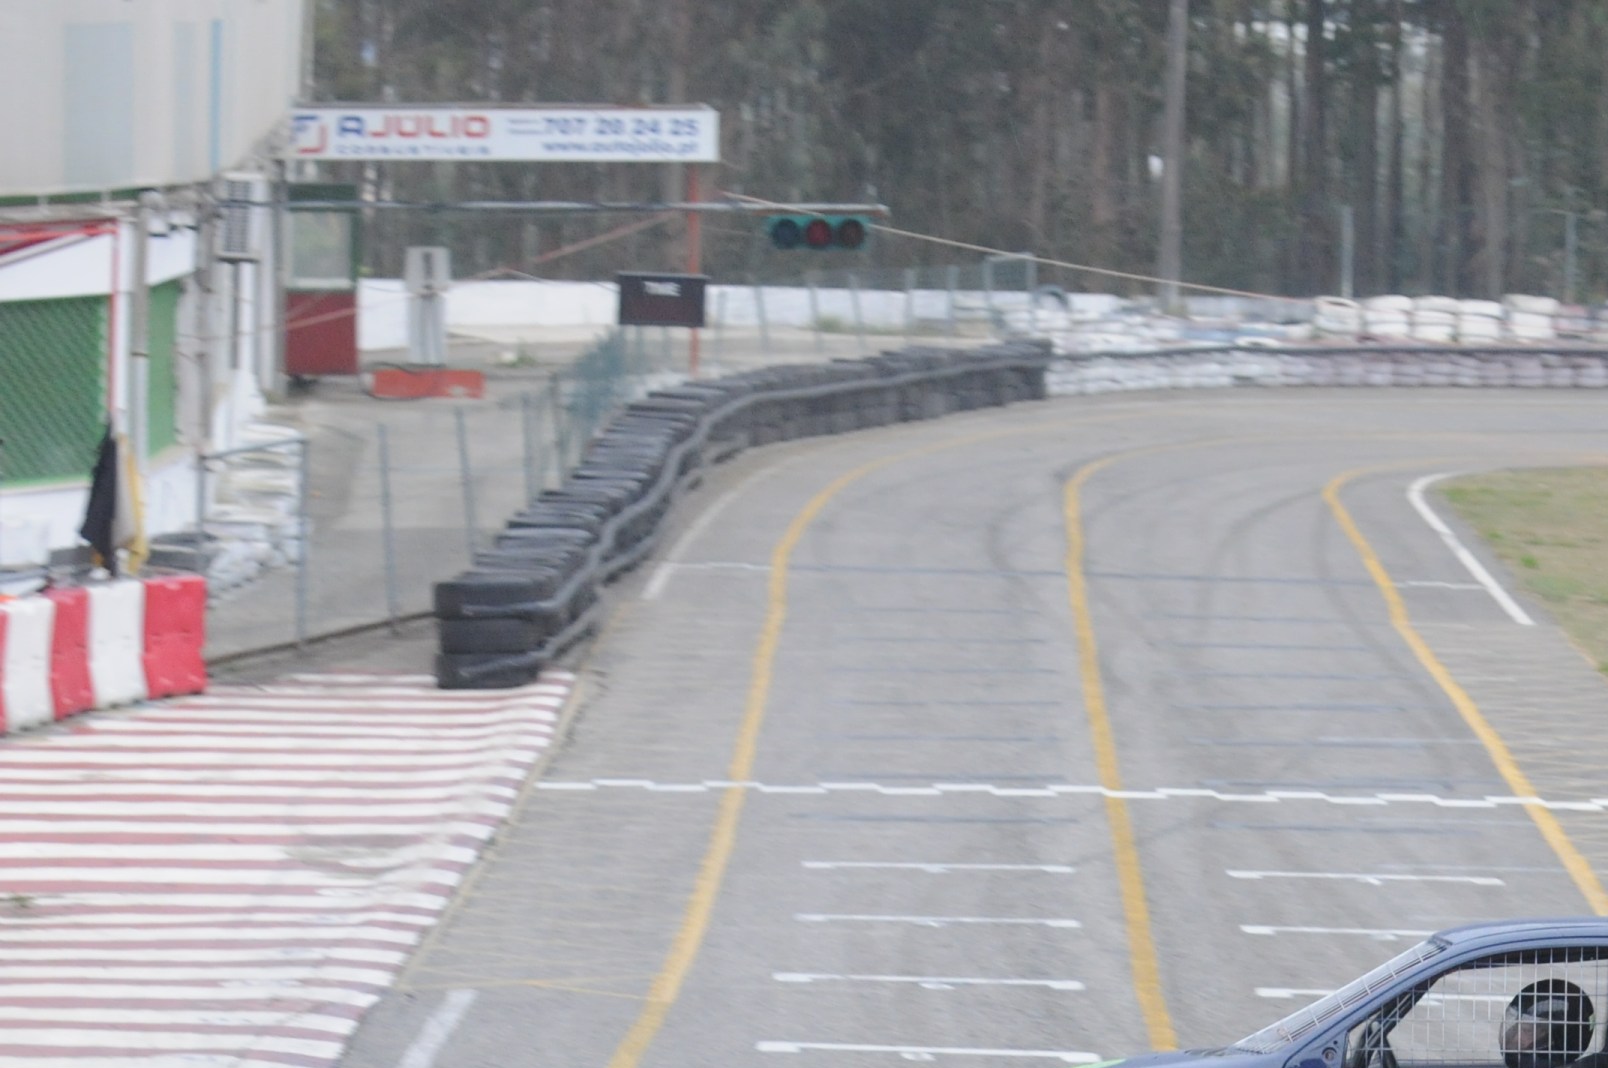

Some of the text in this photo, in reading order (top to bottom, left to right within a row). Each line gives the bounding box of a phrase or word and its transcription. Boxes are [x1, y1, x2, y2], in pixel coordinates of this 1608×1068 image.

[543, 117, 587, 135] 707
[595, 117, 625, 135] 20
[633, 118, 661, 136] 24
[669, 118, 700, 136] 25
